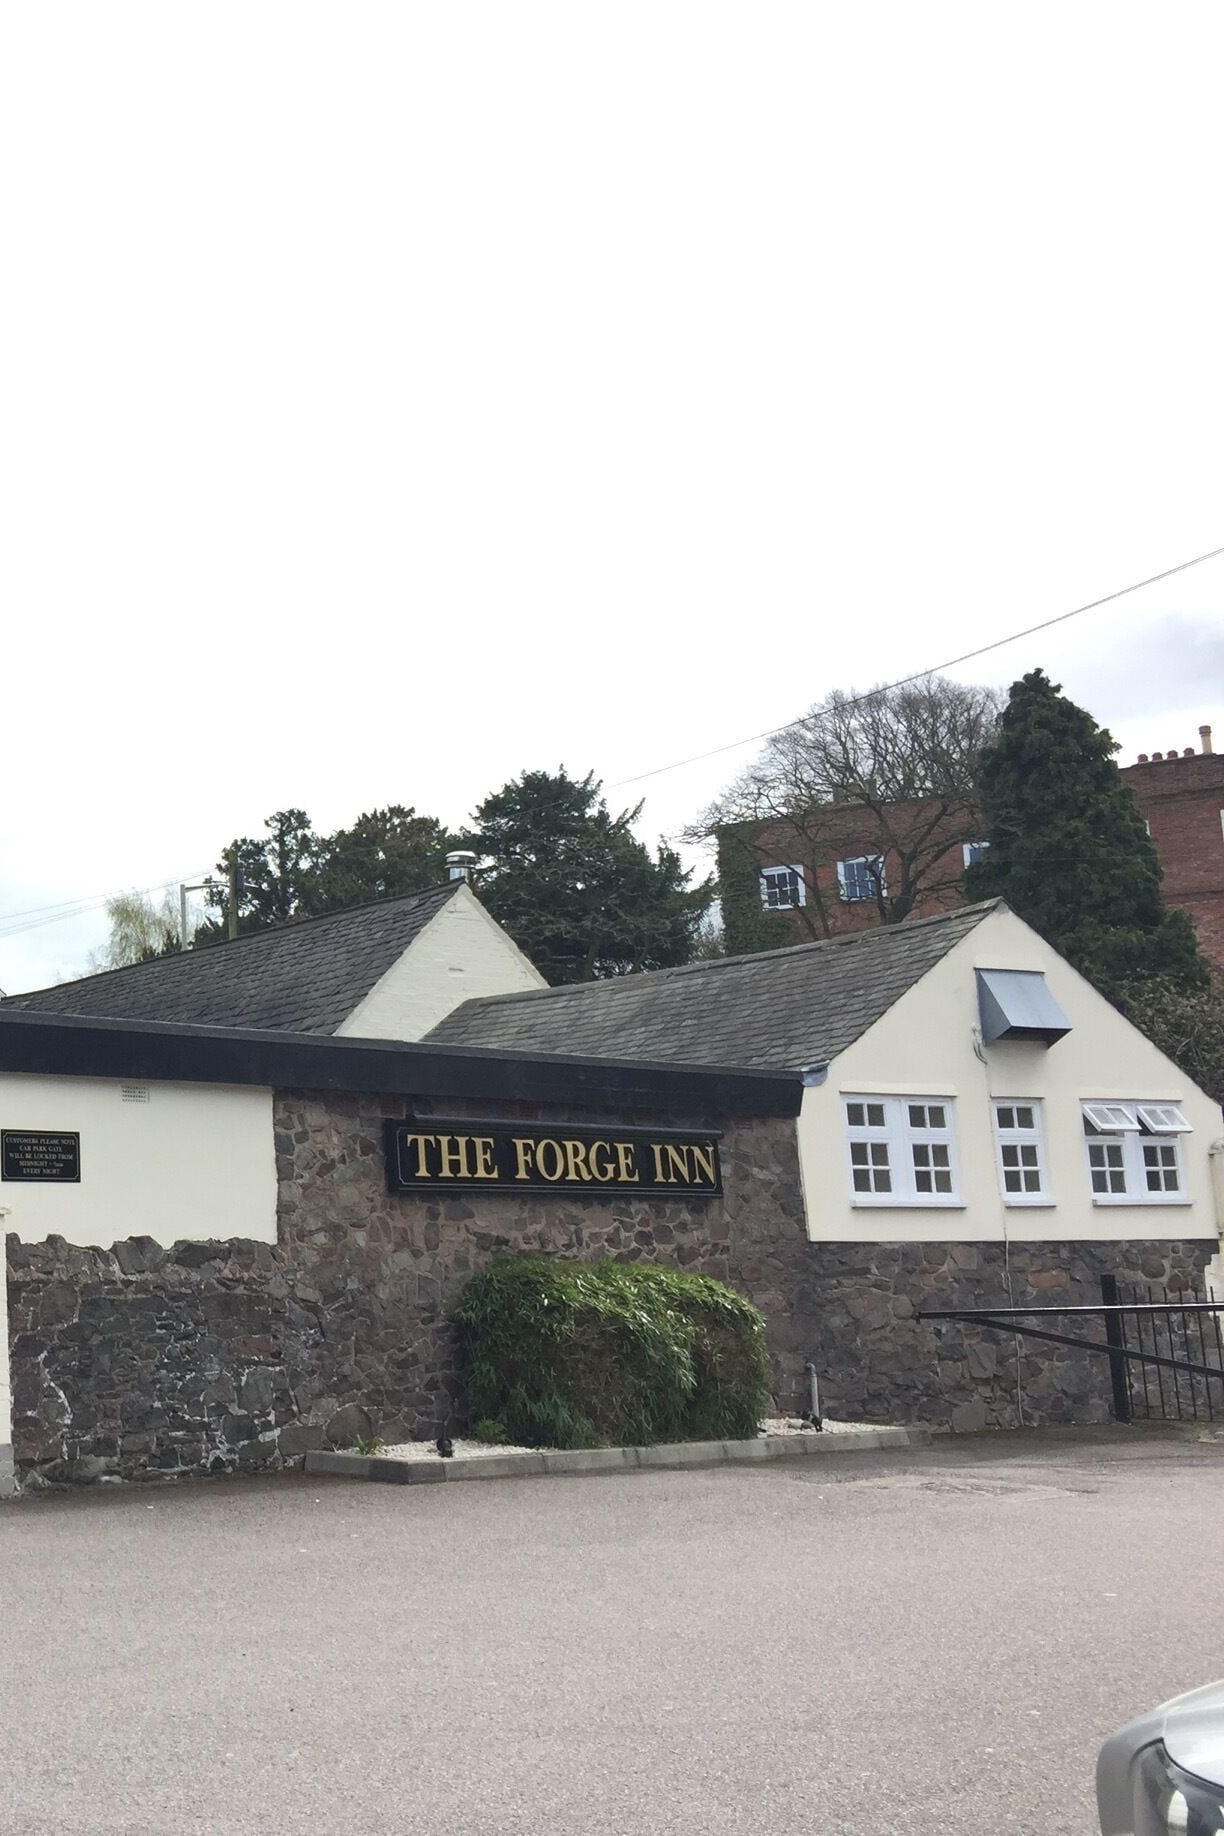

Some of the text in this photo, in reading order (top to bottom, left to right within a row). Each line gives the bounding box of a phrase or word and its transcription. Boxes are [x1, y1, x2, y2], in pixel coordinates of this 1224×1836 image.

[406, 1134, 716, 1185] THE FORGE INN
